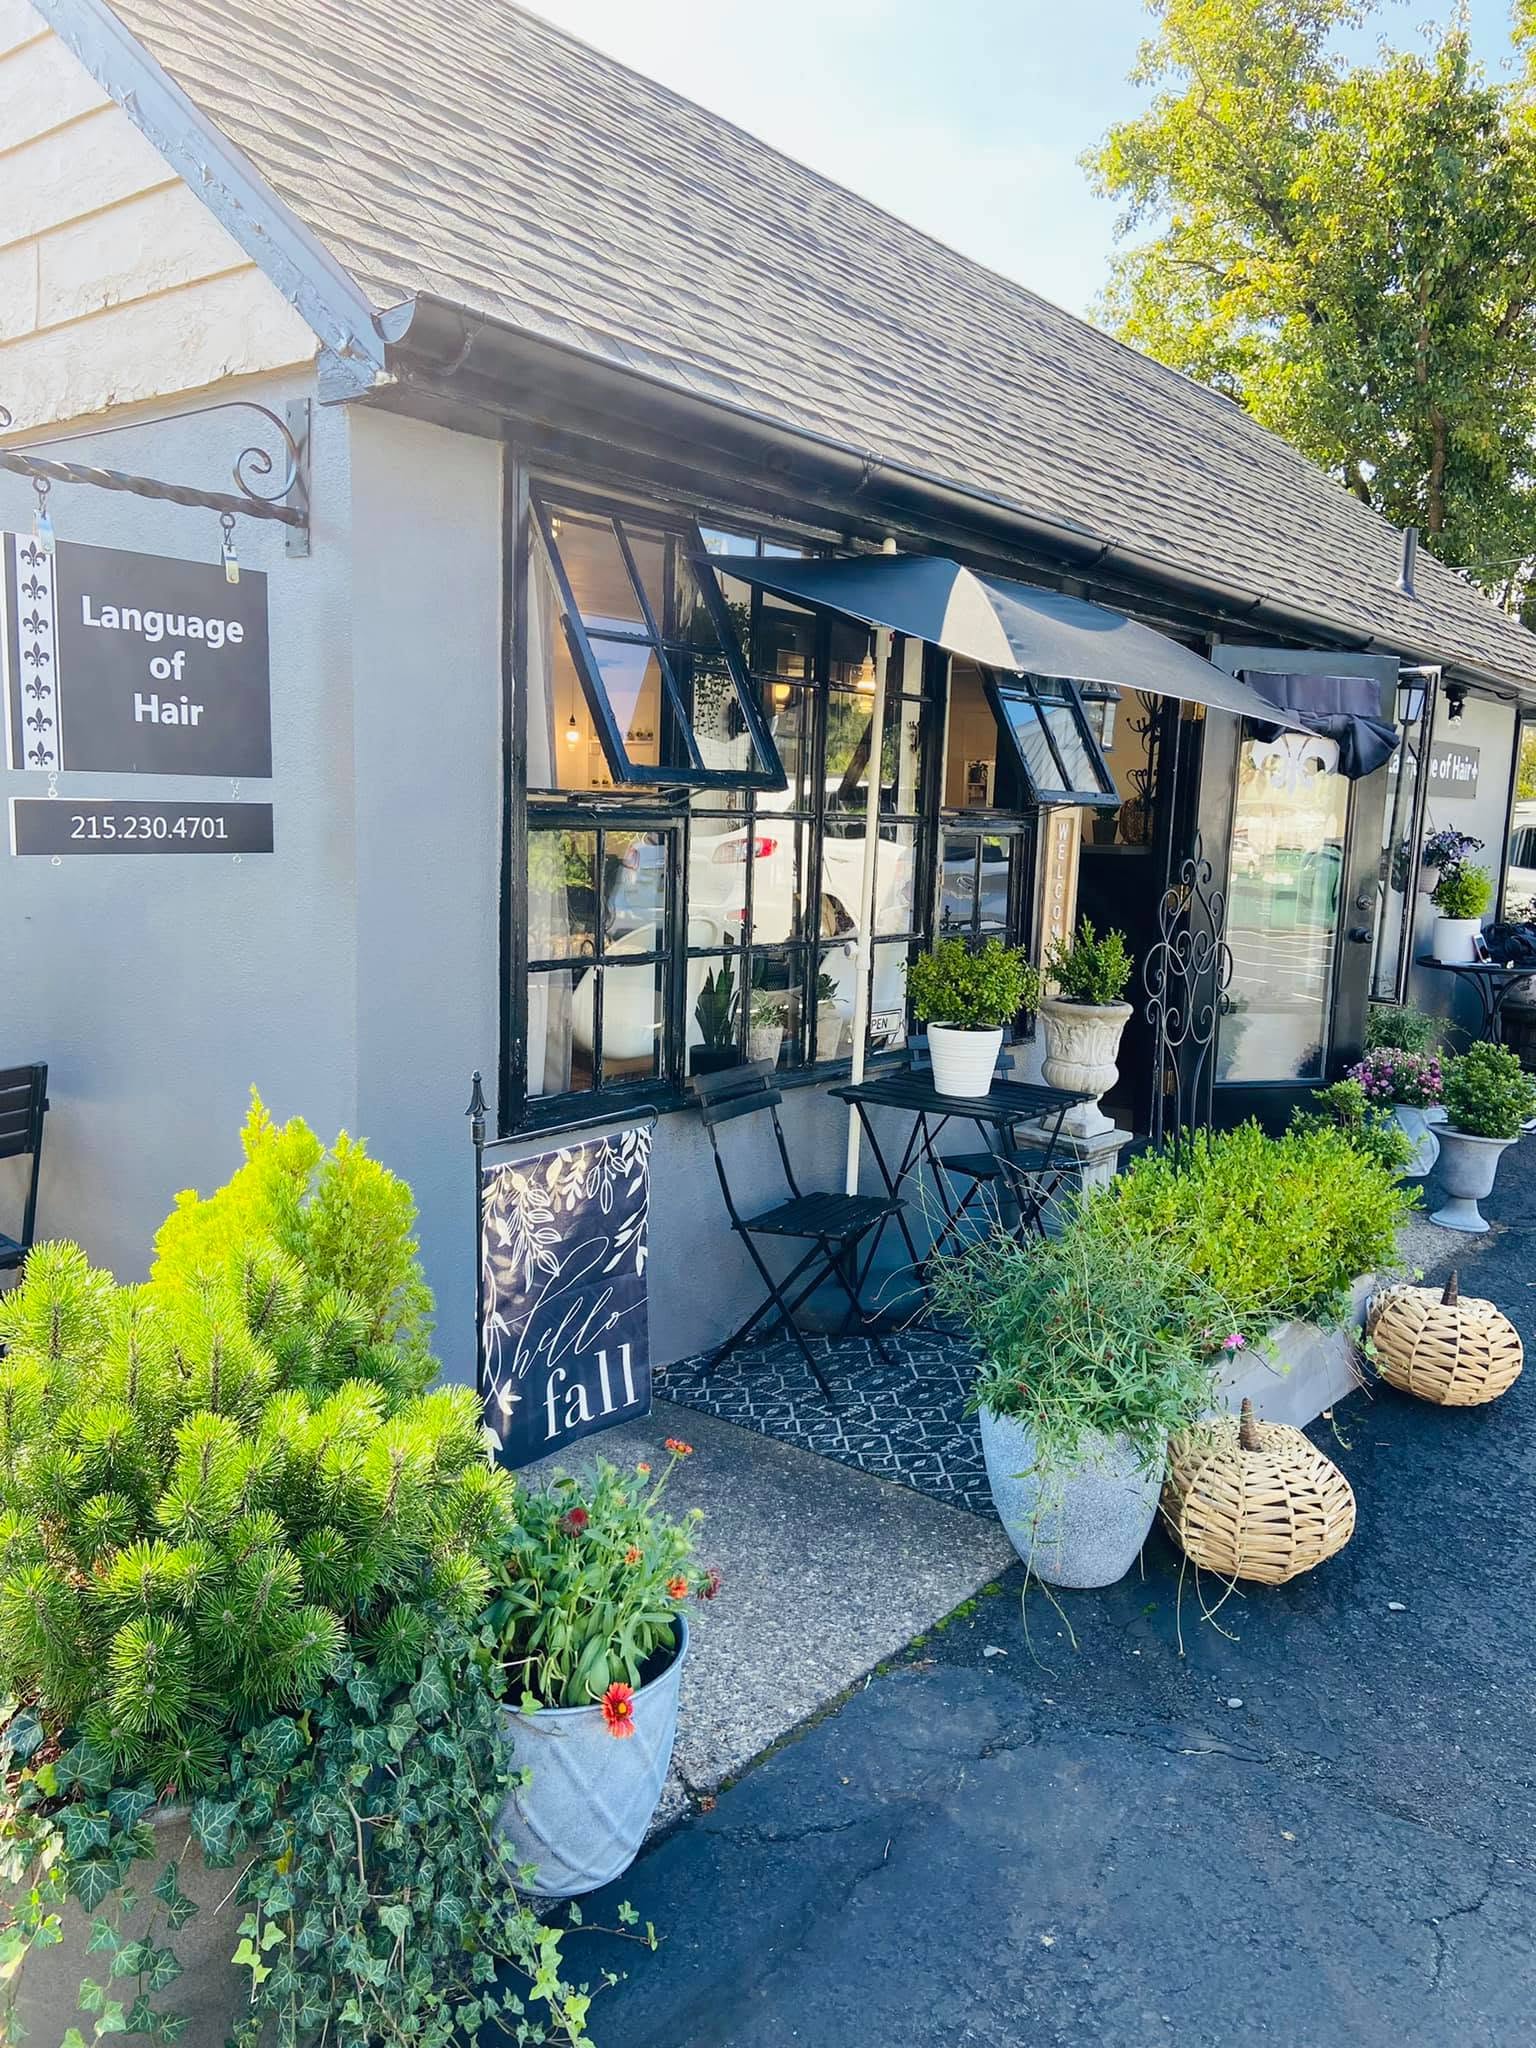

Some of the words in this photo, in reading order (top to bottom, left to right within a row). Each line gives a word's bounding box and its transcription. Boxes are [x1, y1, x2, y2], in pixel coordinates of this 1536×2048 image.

[82, 595, 244, 648] Language
[149, 650, 186, 681] of
[133, 693, 204, 726] Hair
[1439, 753, 1452, 780] of
[1451, 755, 1471, 781] Hair
[70, 815, 228, 839] 215.230.4701
[1050, 823, 1069, 959] WELCOM
[871, 1017, 888, 1030] PEN
[487, 1236, 649, 1379] hello
[542, 1343, 640, 1440] fall
